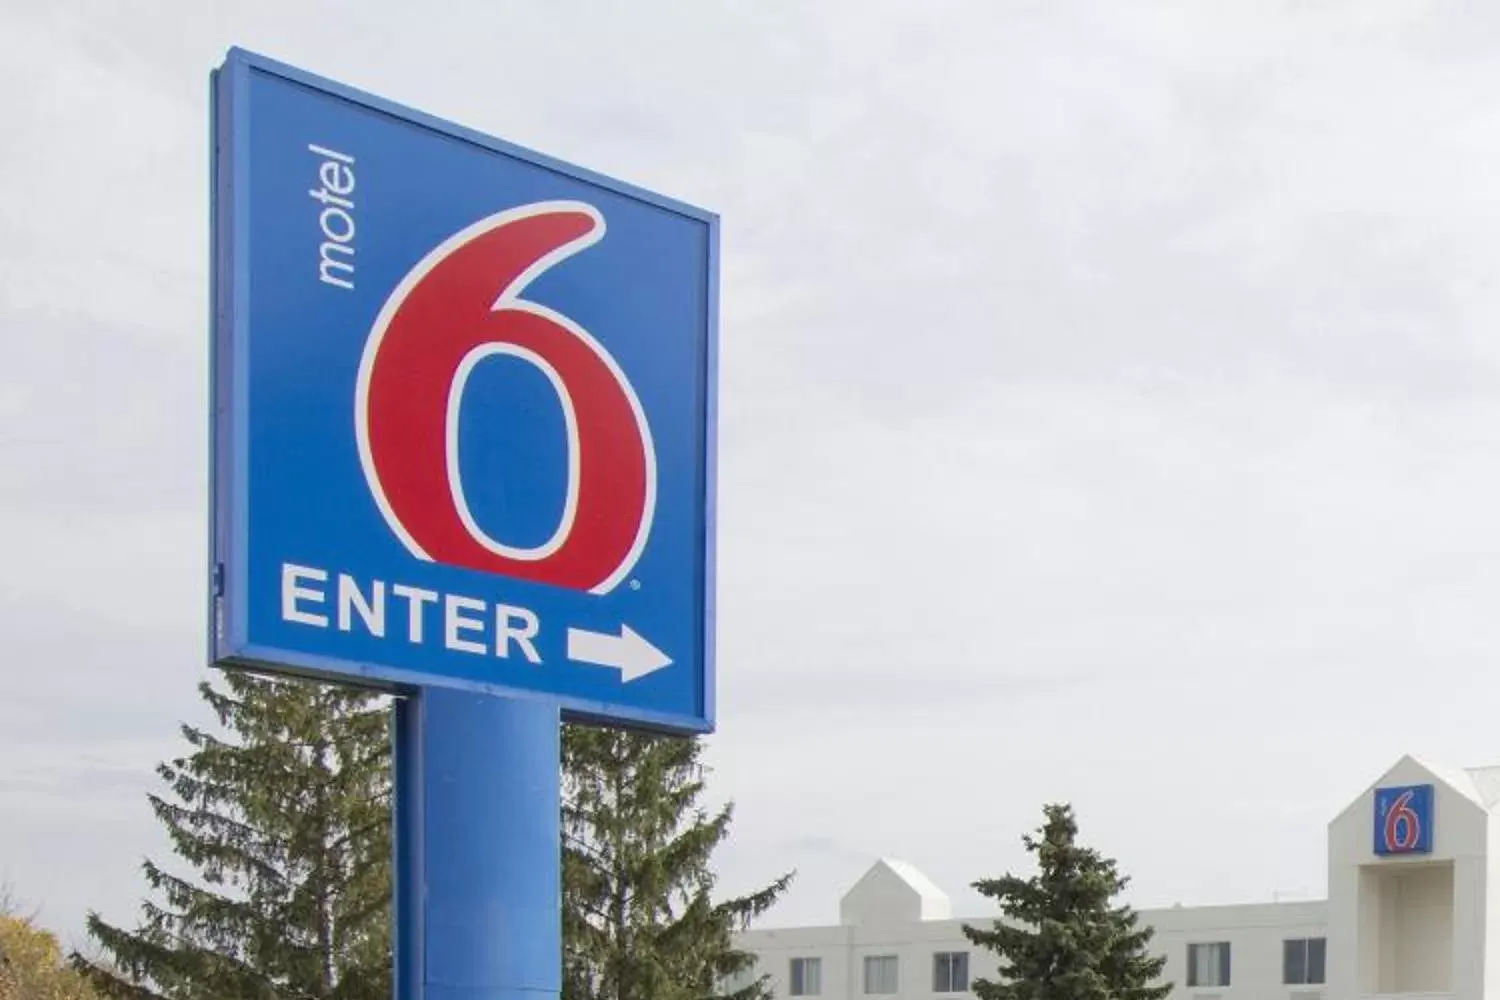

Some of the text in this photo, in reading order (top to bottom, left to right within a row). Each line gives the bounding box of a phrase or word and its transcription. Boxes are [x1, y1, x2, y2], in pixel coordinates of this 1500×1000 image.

[308, 144, 356, 289] motel
[355, 200, 657, 595] 6
[280, 563, 542, 664] ENTER
[1385, 789, 1419, 852] 6
